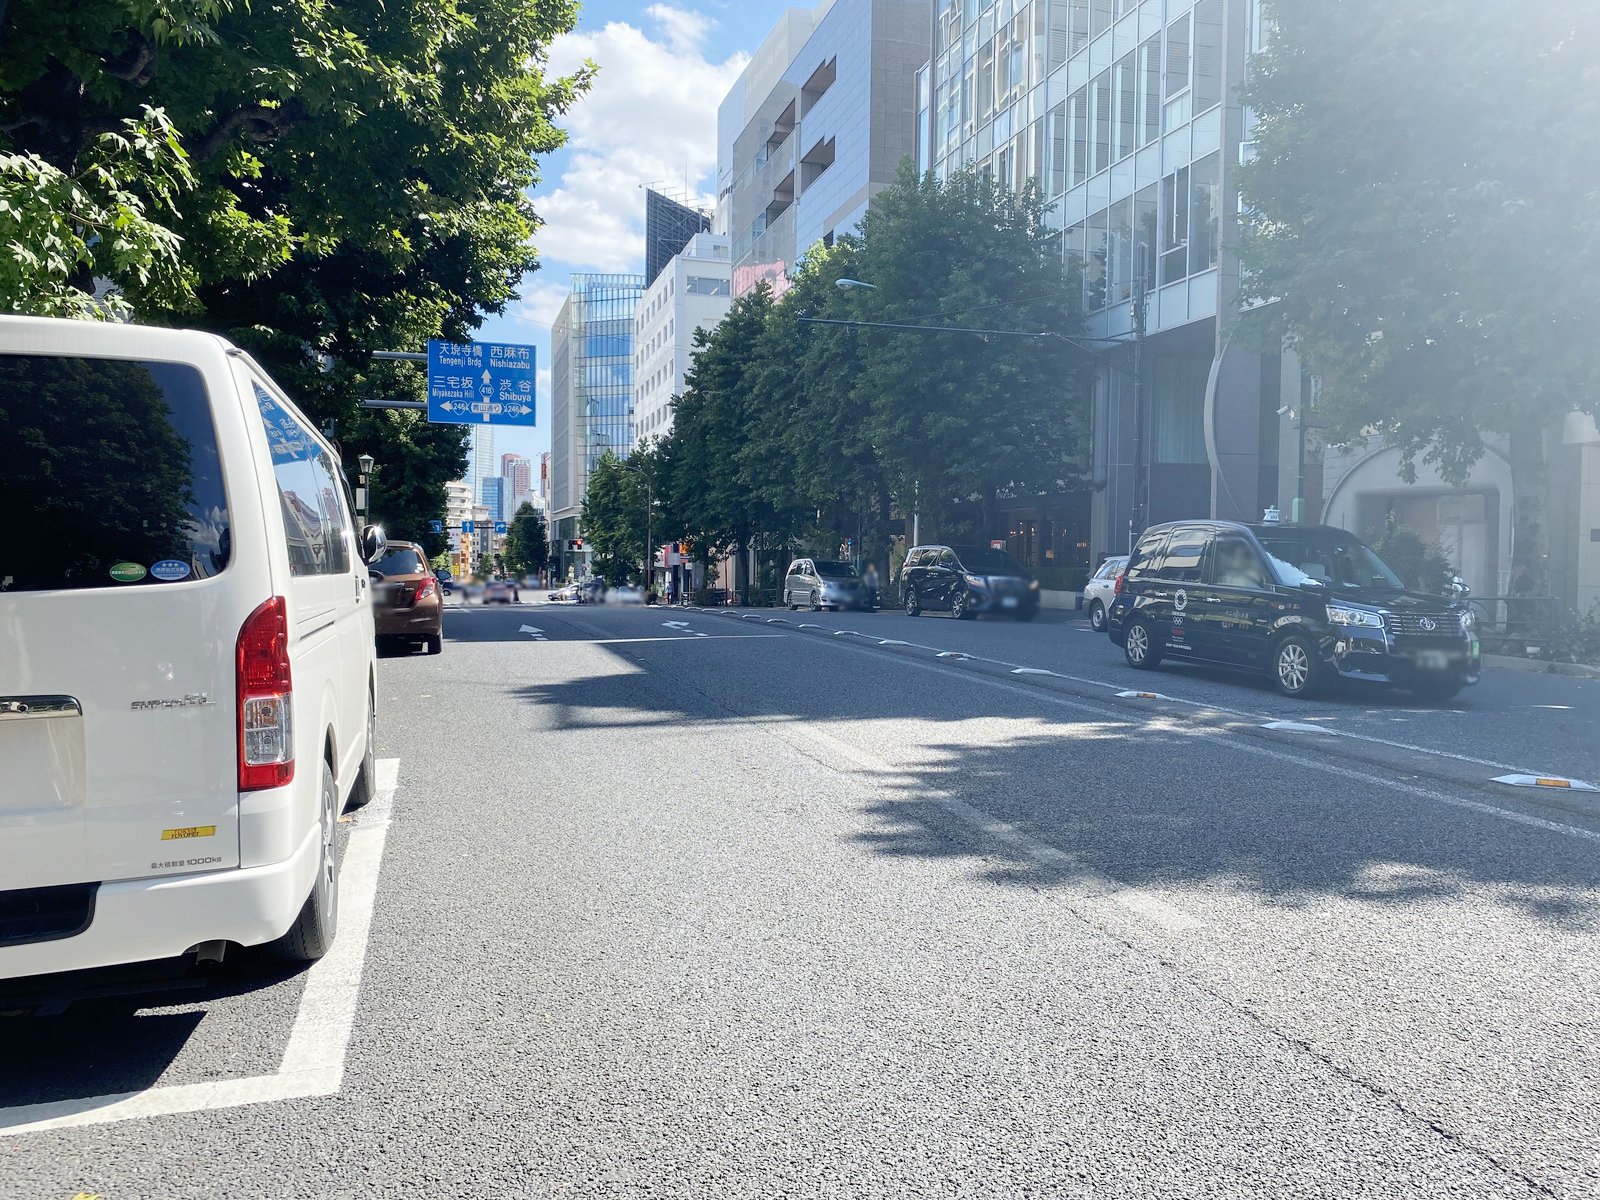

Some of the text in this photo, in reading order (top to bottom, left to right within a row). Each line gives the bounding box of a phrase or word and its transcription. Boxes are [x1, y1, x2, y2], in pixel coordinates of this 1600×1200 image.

[490, 346, 530, 360] 西麻布
[439, 356, 466, 367] Tengenji
[490, 359, 531, 370] Nishiazabu
[433, 375, 474, 389] 三宅坂
[432, 388, 475, 399] Miyakezaka Hill
[481, 387, 492, 395] 418
[500, 391, 532, 403] Shibuya
[507, 405, 520, 413] 246
[187, 856, 222, 866] 1000kg
